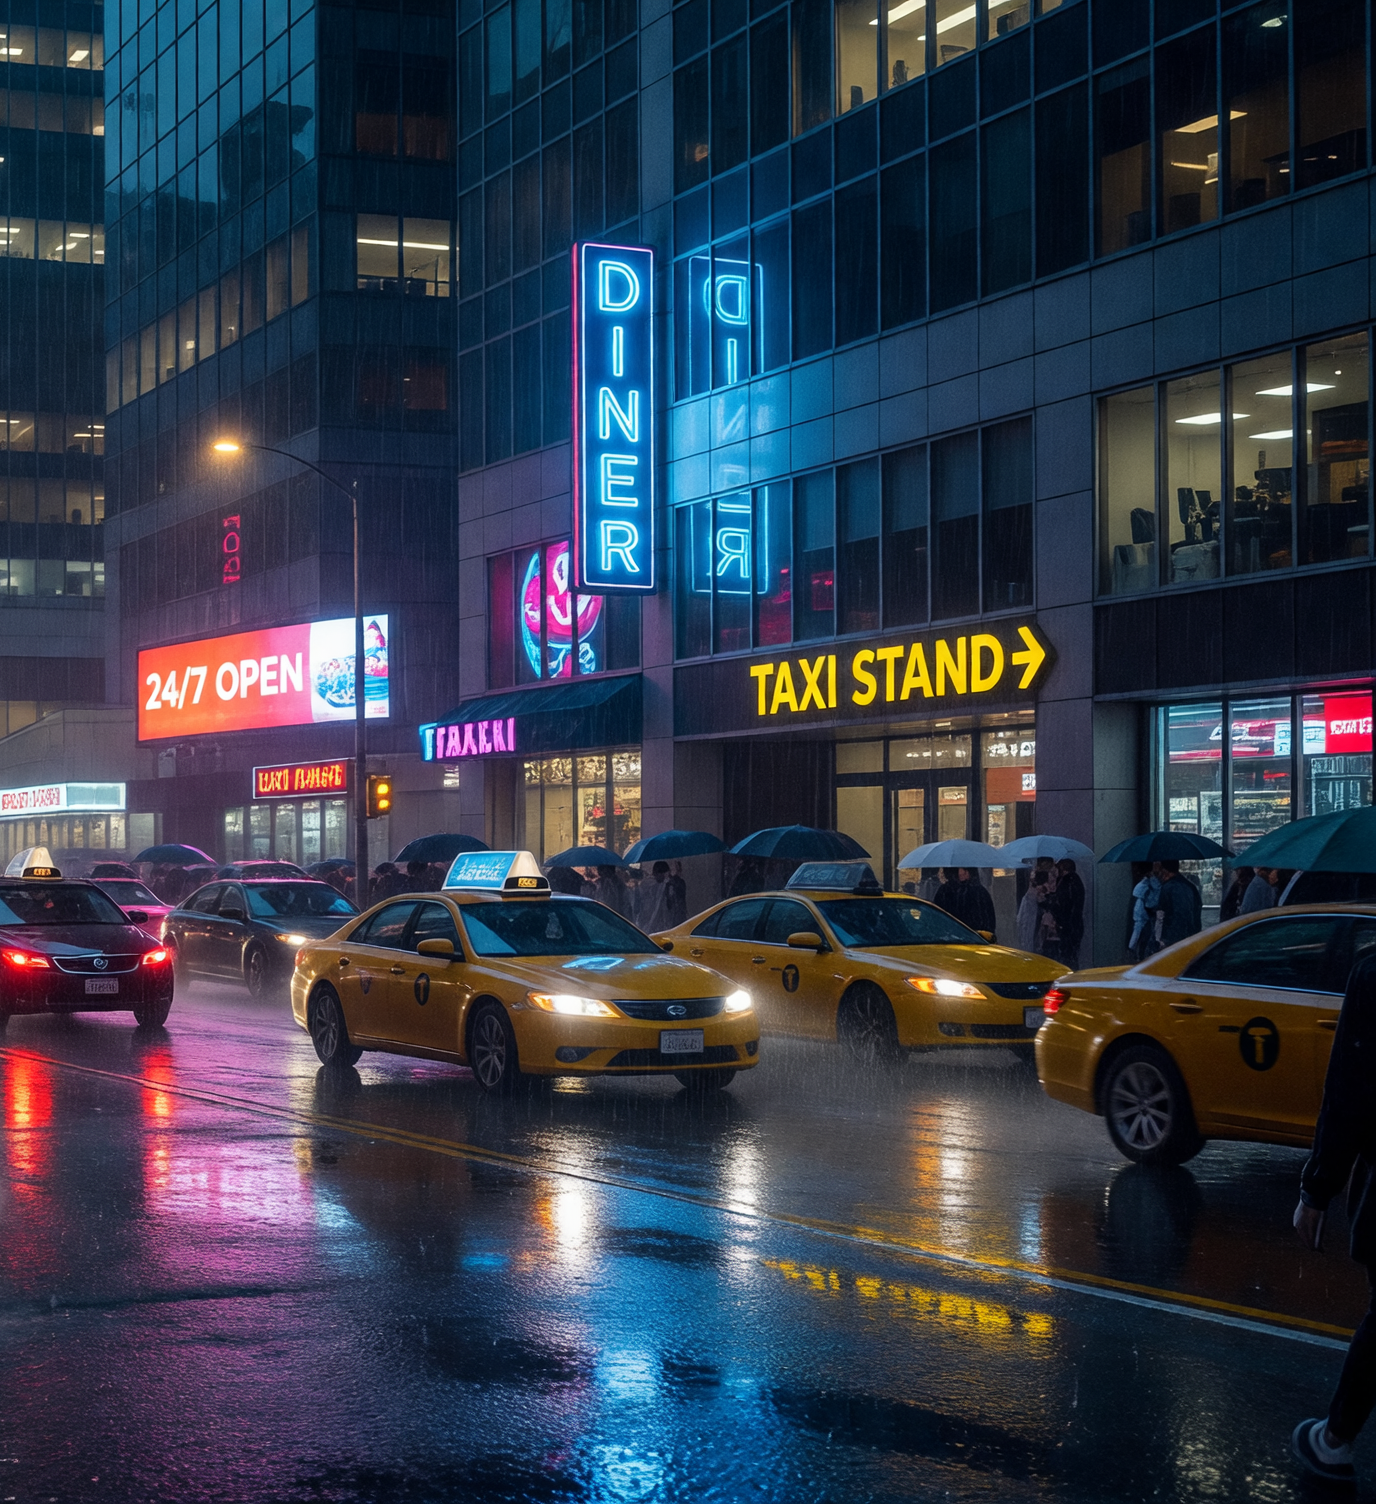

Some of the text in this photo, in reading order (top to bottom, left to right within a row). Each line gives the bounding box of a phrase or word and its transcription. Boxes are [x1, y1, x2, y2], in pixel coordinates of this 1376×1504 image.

[598, 259, 641, 573] DINER
[145, 652, 304, 711] 24/7 OPEN
[749, 633, 1005, 716] TAXI STAND
